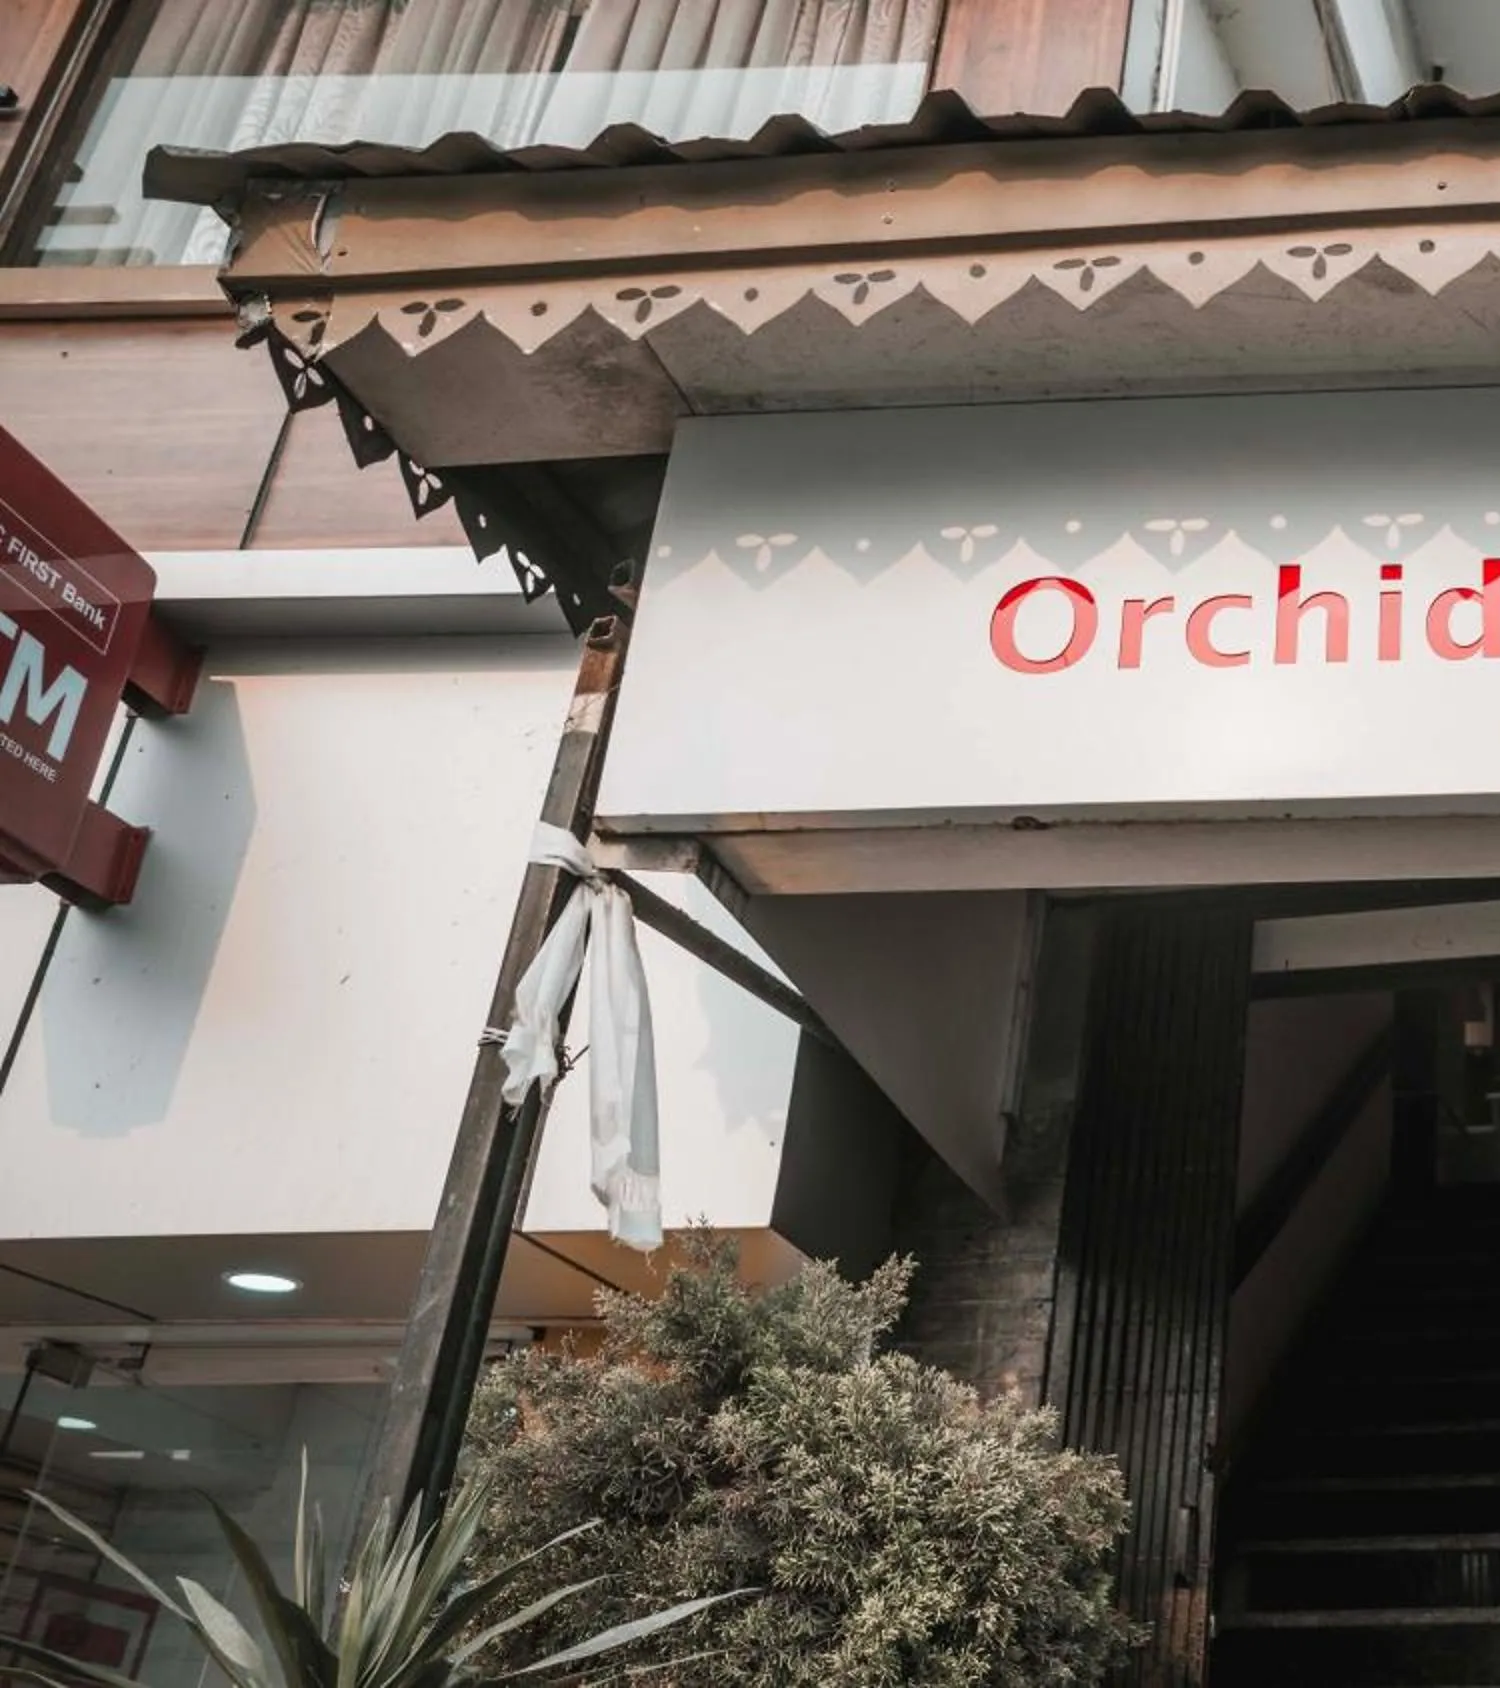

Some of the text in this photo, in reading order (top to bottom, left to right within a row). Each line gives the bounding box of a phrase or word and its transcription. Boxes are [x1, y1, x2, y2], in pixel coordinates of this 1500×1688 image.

[7, 536, 106, 630] FIRST Bank
[23, 751, 57, 783] HERE
